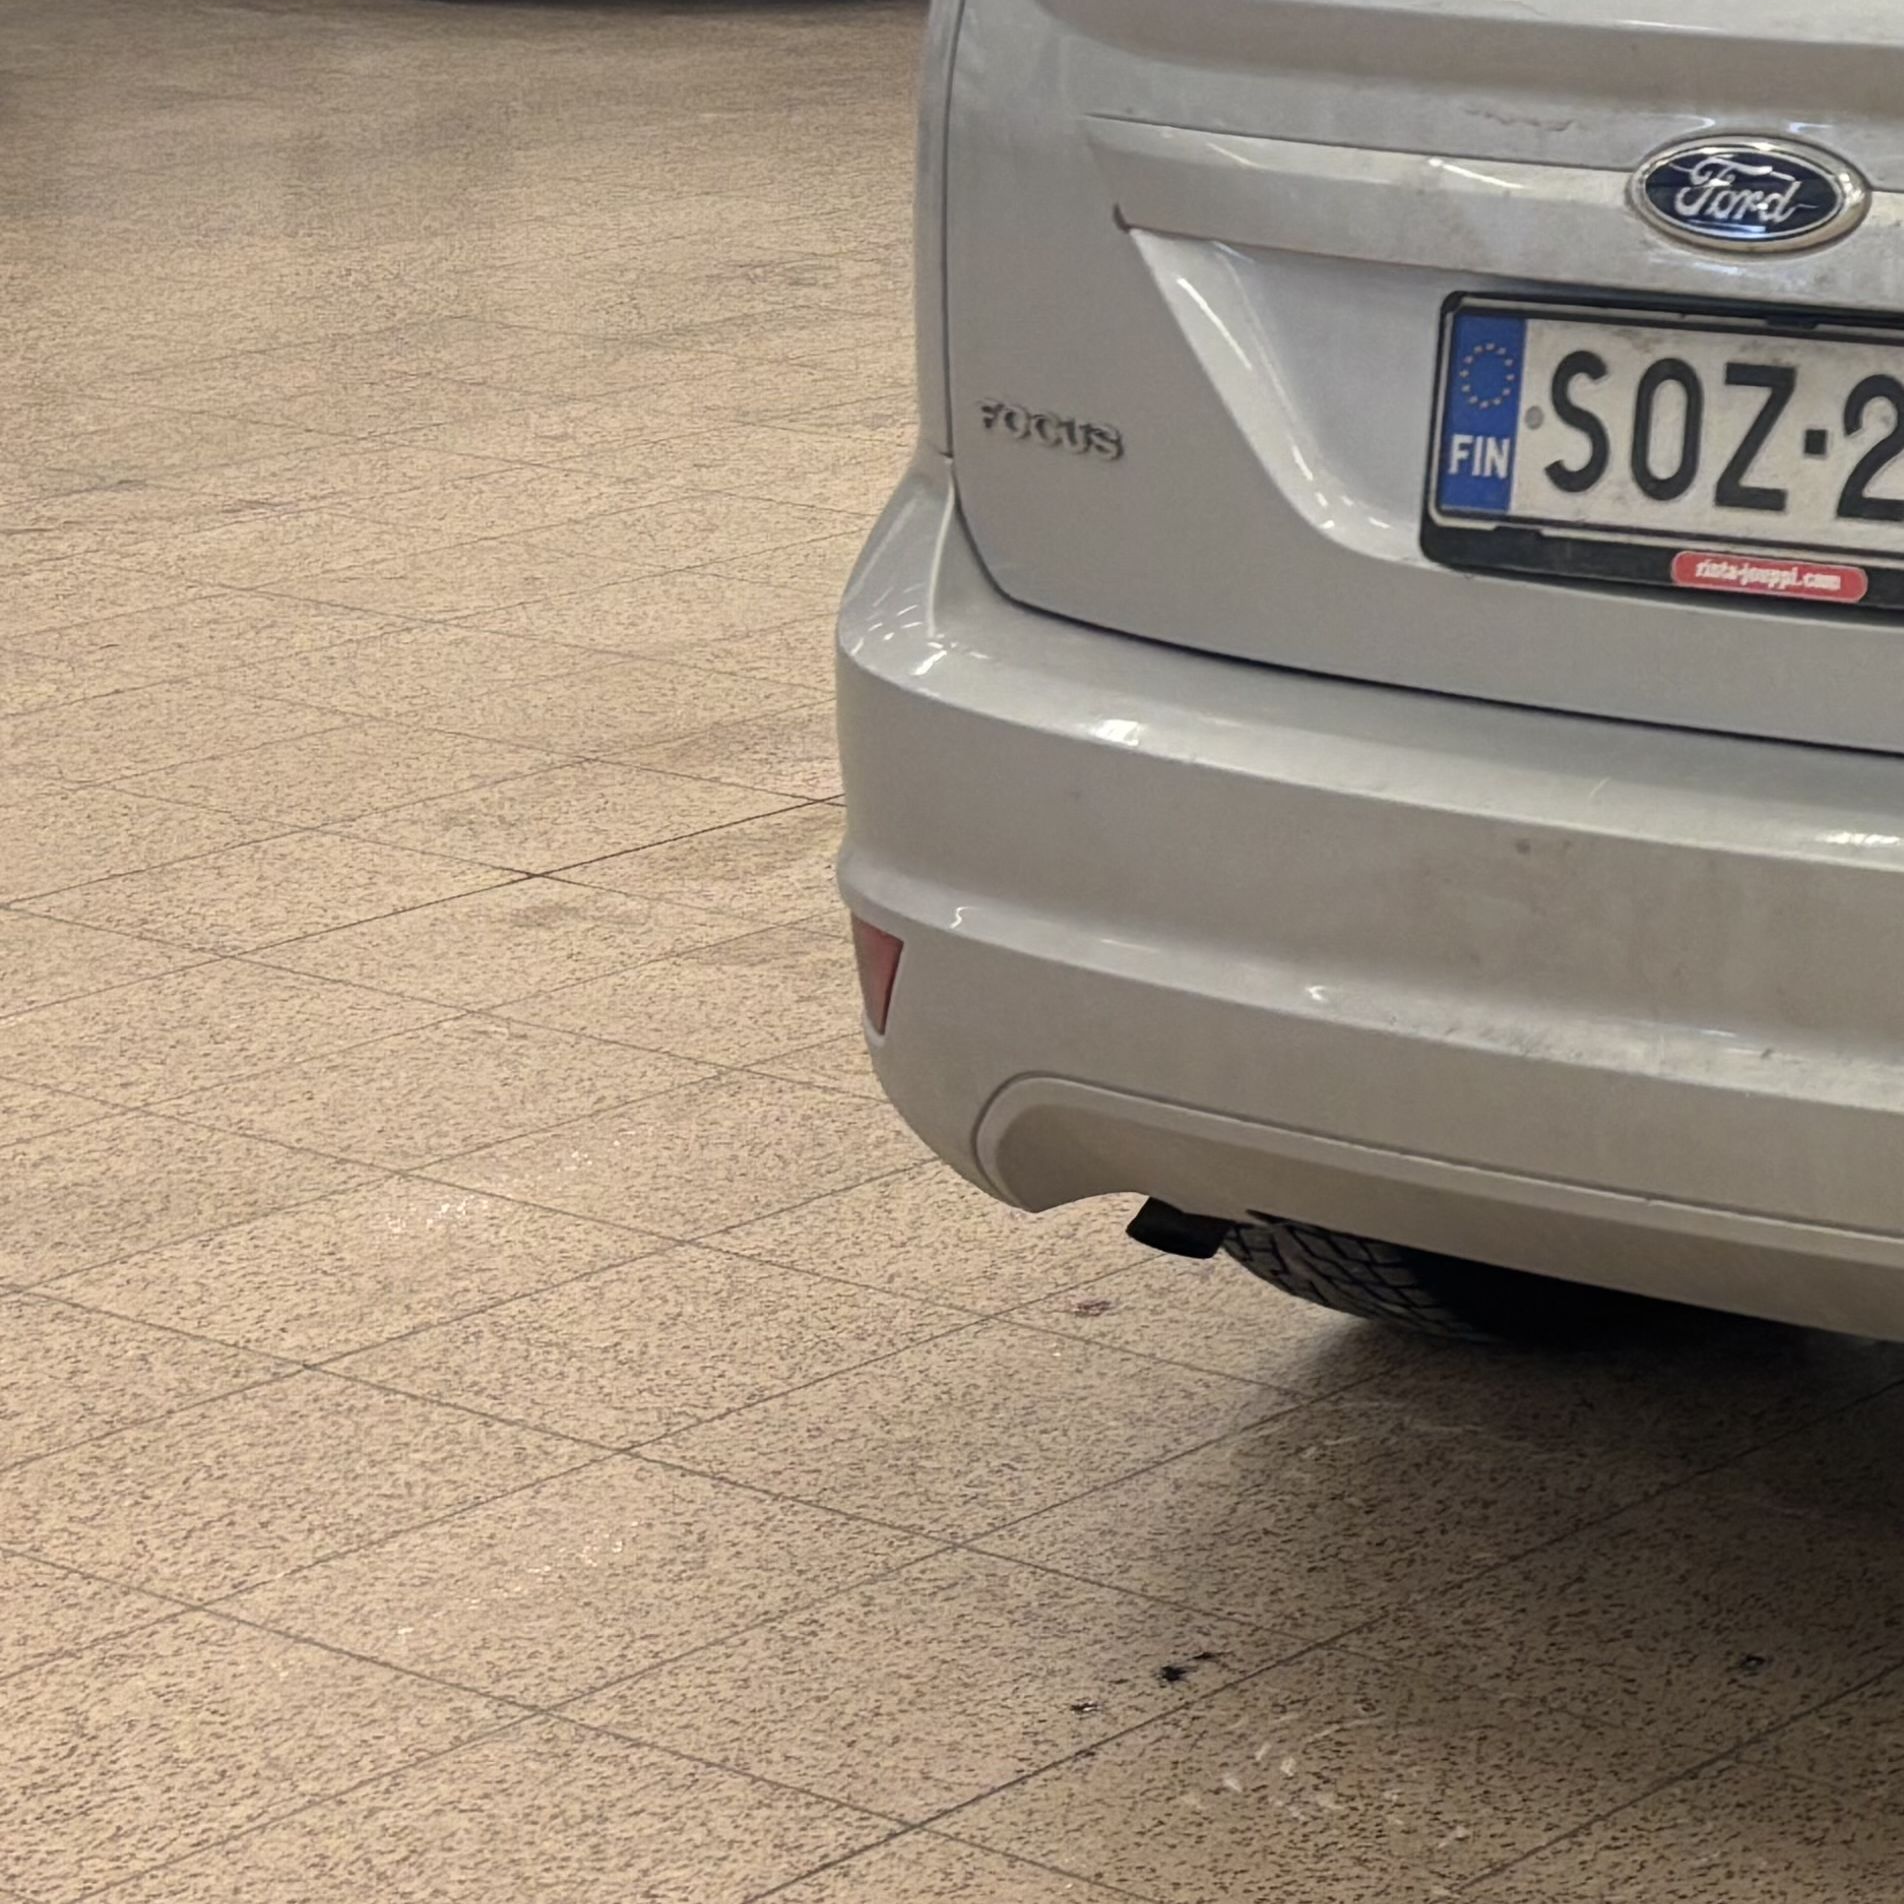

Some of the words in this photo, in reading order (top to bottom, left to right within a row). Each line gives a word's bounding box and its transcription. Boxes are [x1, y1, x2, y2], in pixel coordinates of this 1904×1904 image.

[1670, 154, 1820, 223] Ford
[979, 399, 1124, 461] FOCUS
[1448, 433, 1509, 480] FIN
